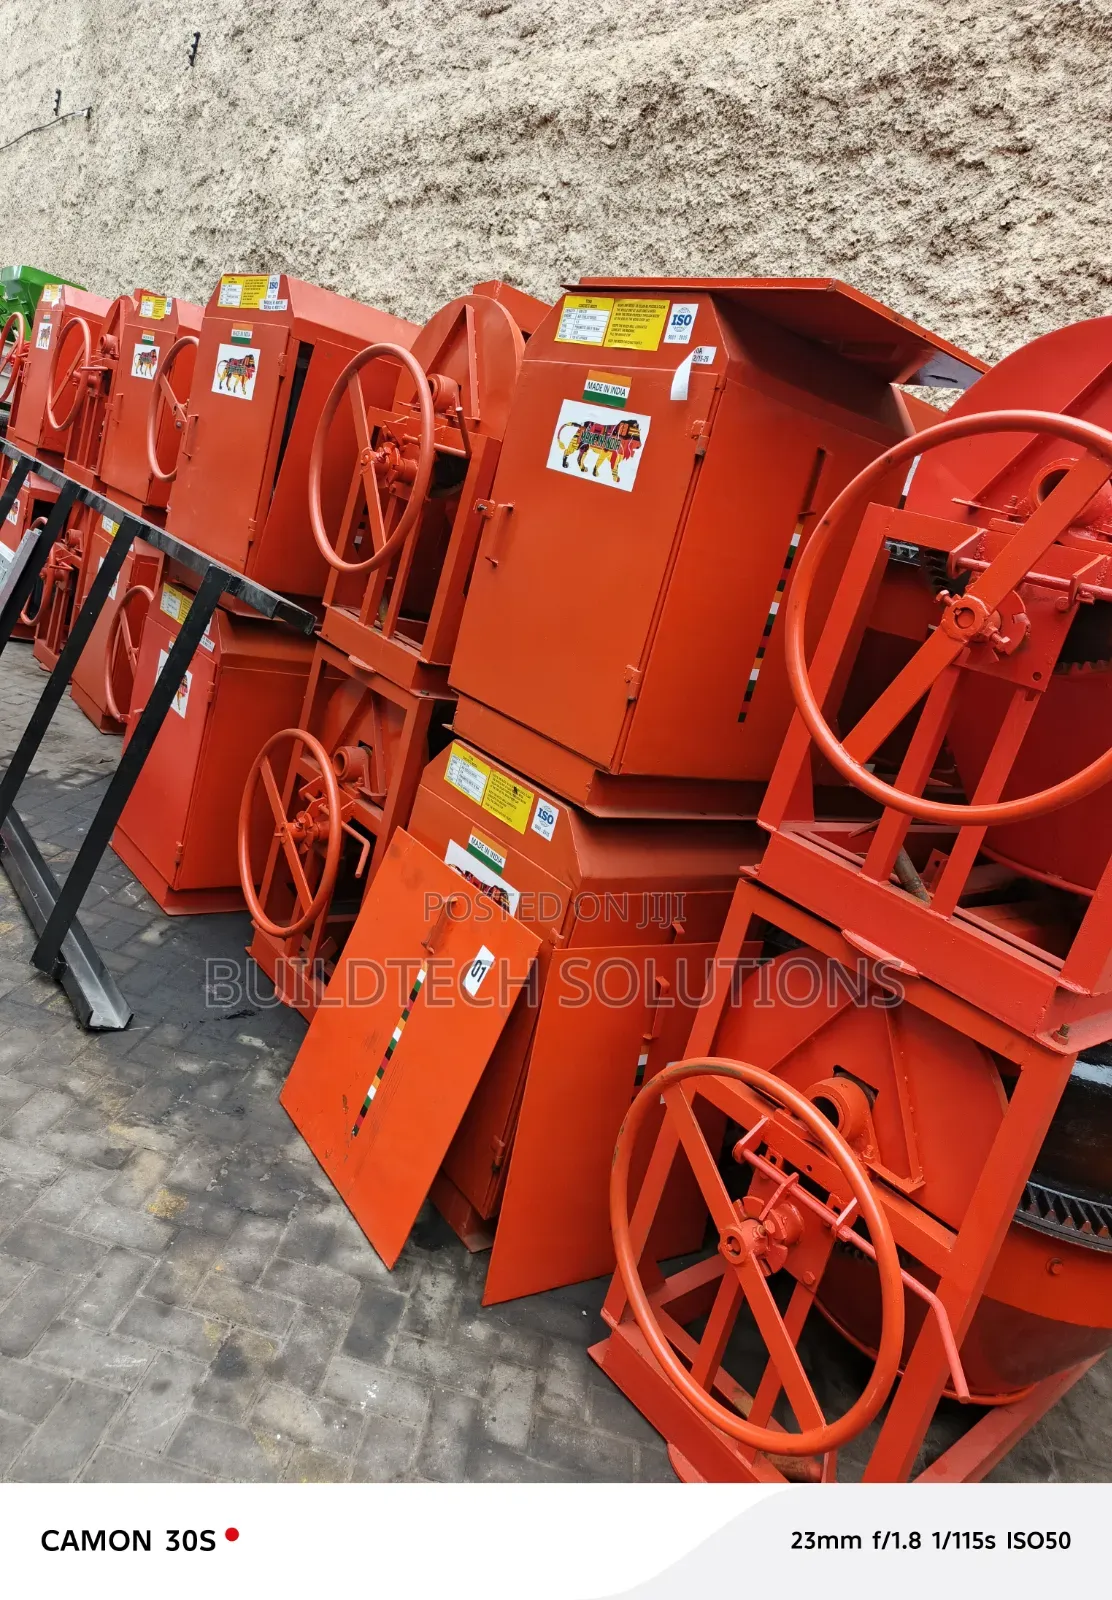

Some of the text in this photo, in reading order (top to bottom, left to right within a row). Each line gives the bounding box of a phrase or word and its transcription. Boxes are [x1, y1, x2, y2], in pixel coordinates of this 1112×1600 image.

[269, 281, 279, 290] ISO
[671, 314, 692, 326] ISO
[586, 381, 626, 396] MADE IN INDIA
[538, 808, 554, 824] ISO
[470, 836, 502, 864] MADE IN INDIA
[470, 959, 486, 982] 01
